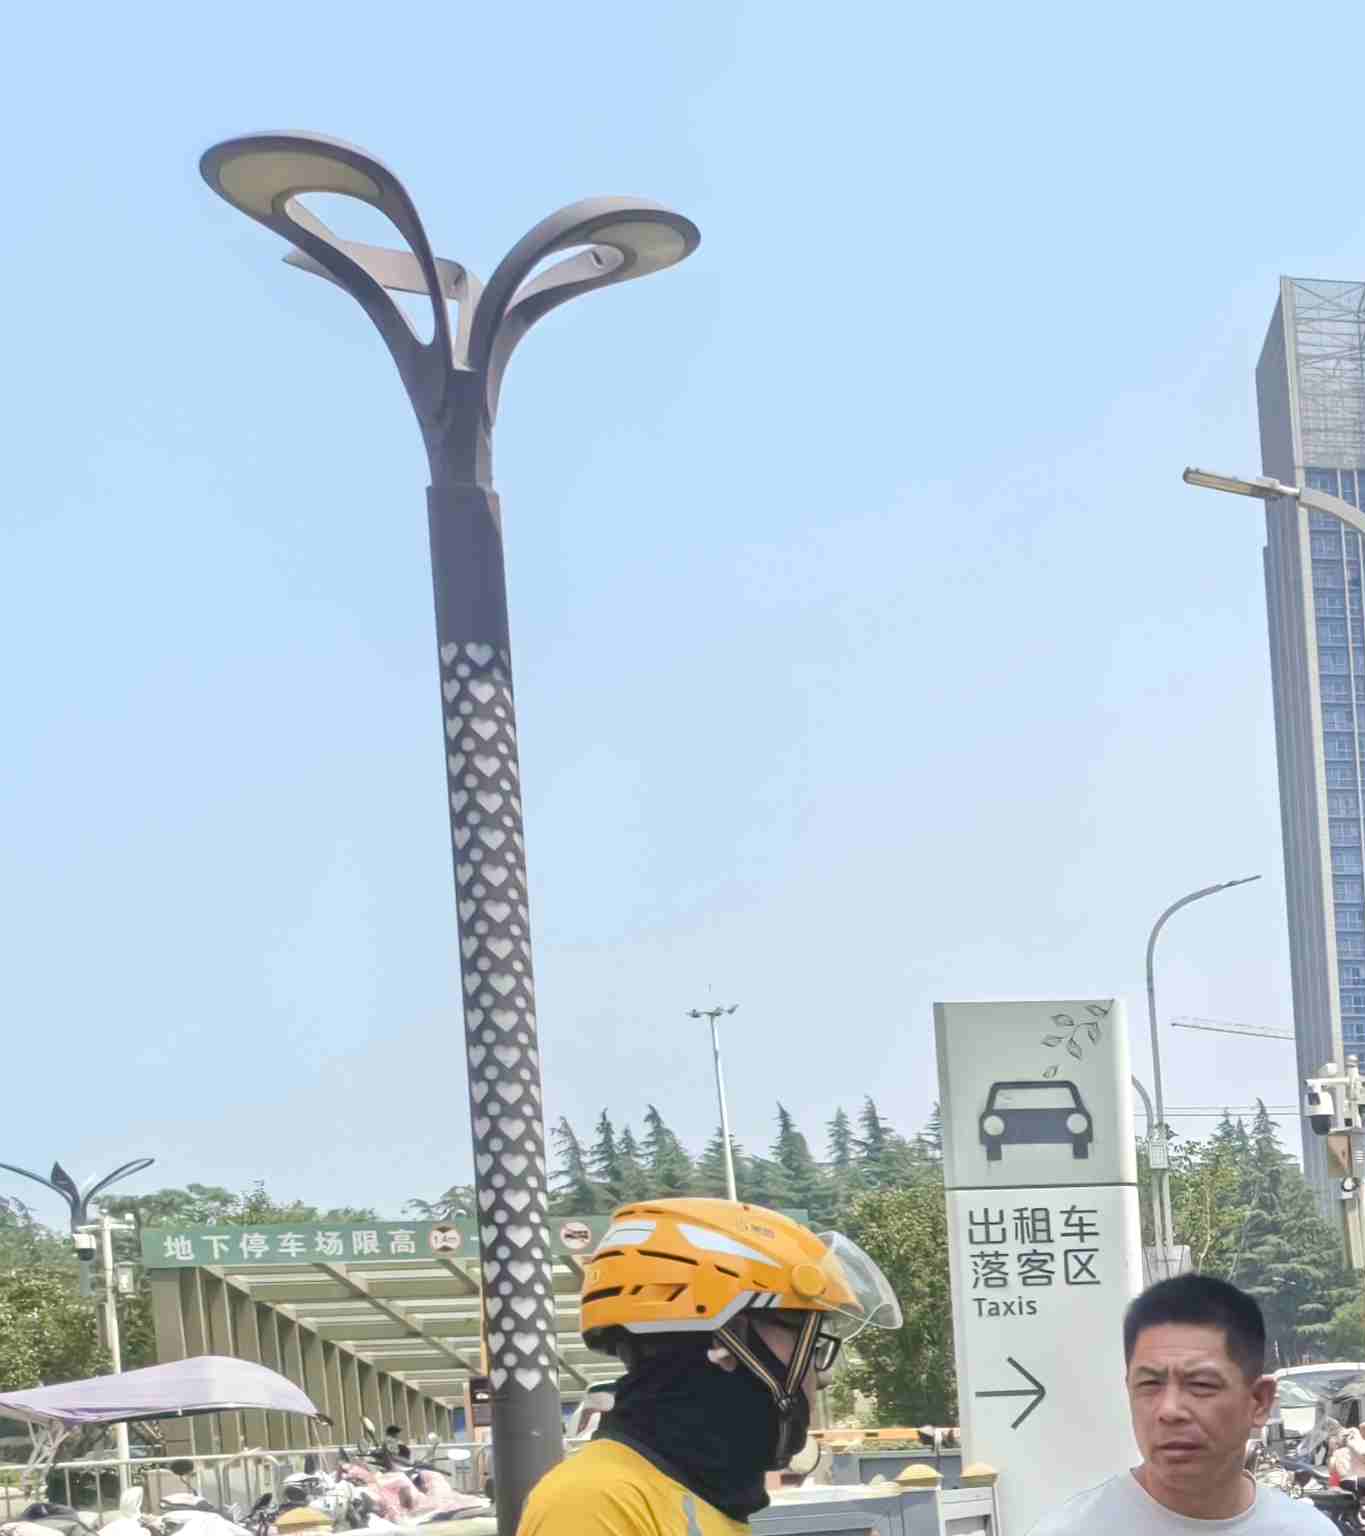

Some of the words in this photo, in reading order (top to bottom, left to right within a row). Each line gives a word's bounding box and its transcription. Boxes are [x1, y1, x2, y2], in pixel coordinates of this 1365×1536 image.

[967, 1204, 1101, 1245] 出租车
[162, 1229, 418, 1262] 地下停车场限高
[969, 1248, 1102, 1289] 落客区
[972, 1295, 1038, 1318] Taxis
